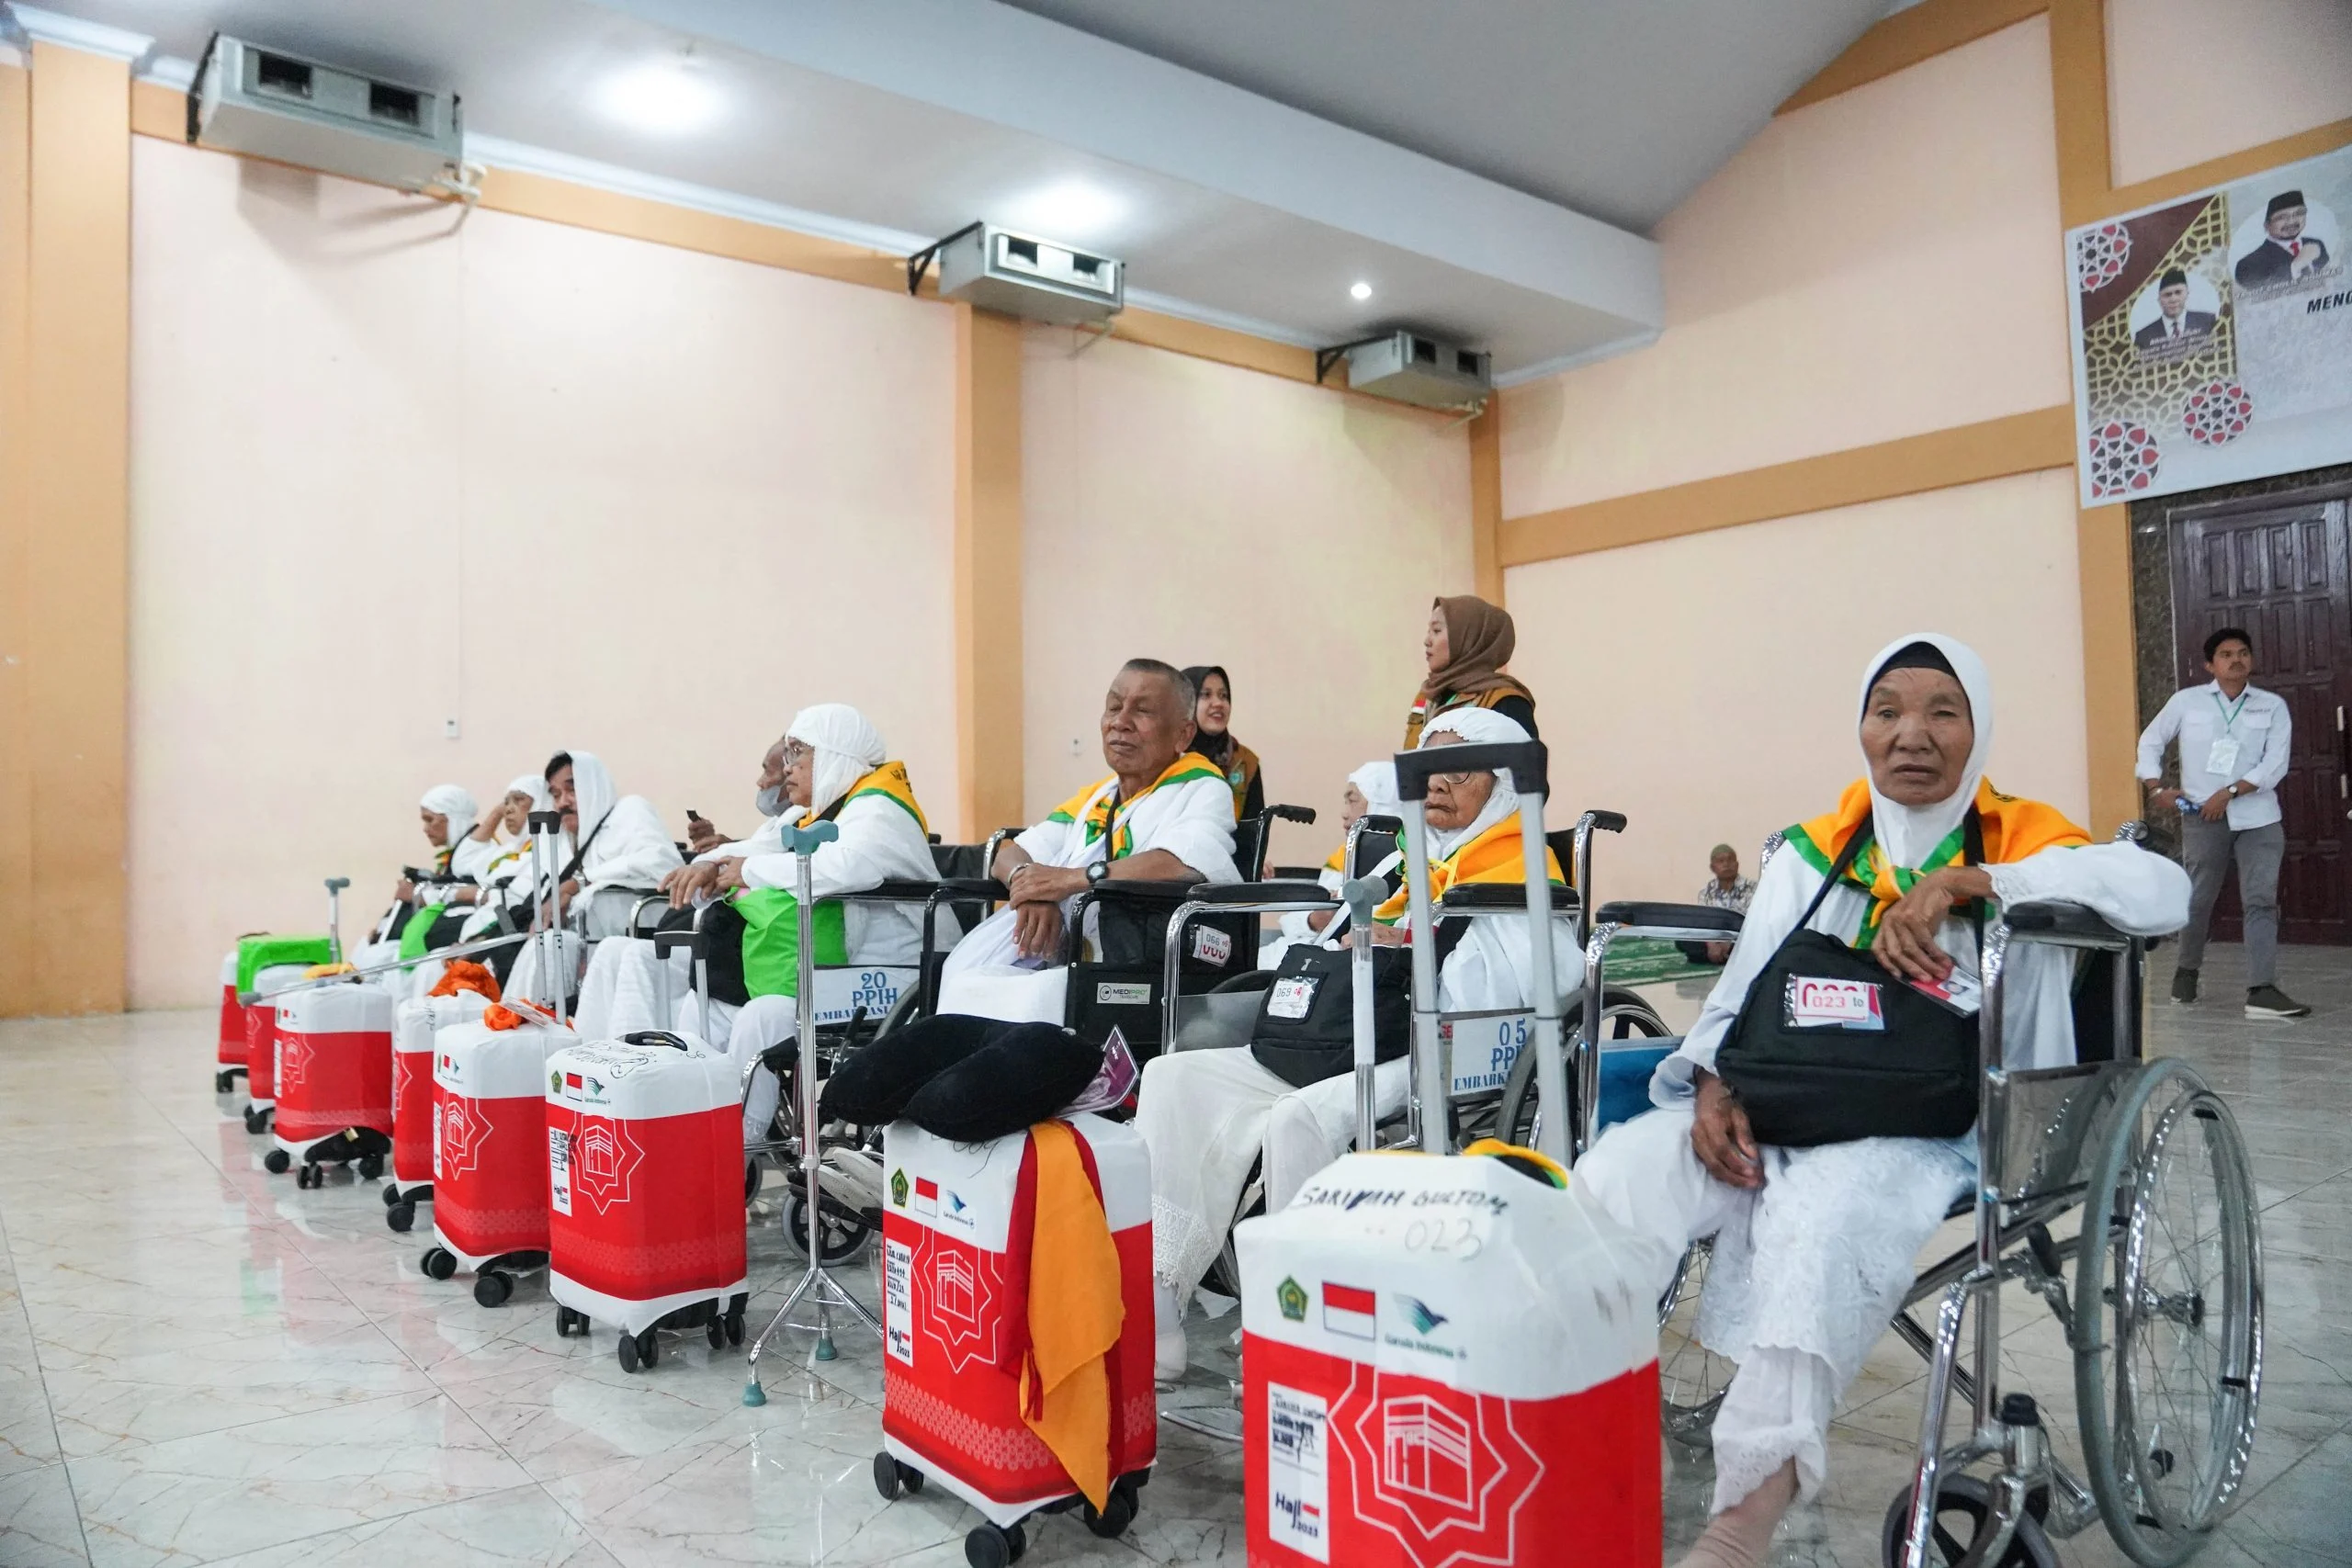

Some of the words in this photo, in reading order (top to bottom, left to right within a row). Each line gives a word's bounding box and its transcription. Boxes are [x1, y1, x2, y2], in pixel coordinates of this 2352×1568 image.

[861, 971, 887, 989] 20
[852, 987, 898, 1008] PPIH
[1813, 996, 1846, 1008] 023
[814, 1005, 888, 1021] EMBAASI
[1498, 1018, 1527, 1046] 05
[1405, 1218, 1483, 1263] 023
